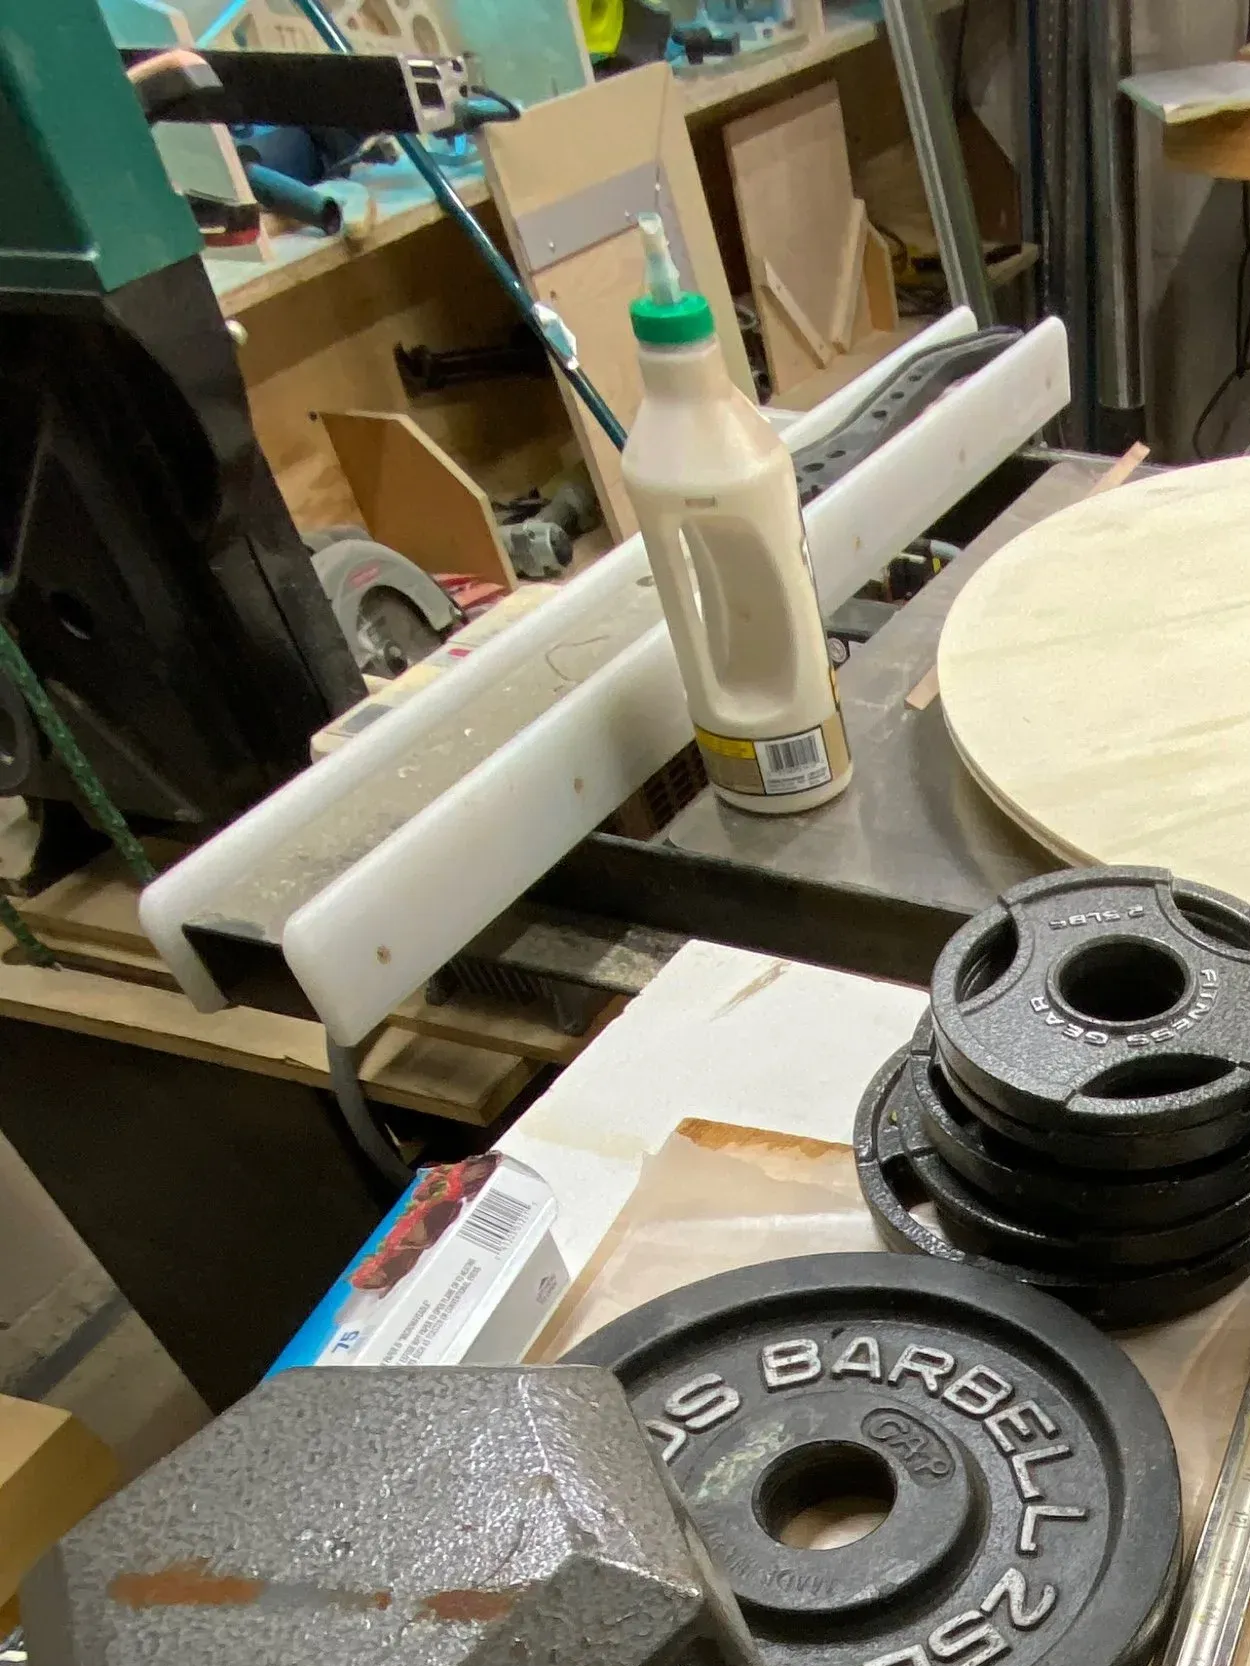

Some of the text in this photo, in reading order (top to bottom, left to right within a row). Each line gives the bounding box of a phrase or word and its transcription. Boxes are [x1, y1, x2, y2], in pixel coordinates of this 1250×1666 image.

[1030, 968, 1219, 1047] FITNESS GEAR
[331, 1330, 359, 1353] 75
[760, 1335, 1088, 1558] BARBELL
